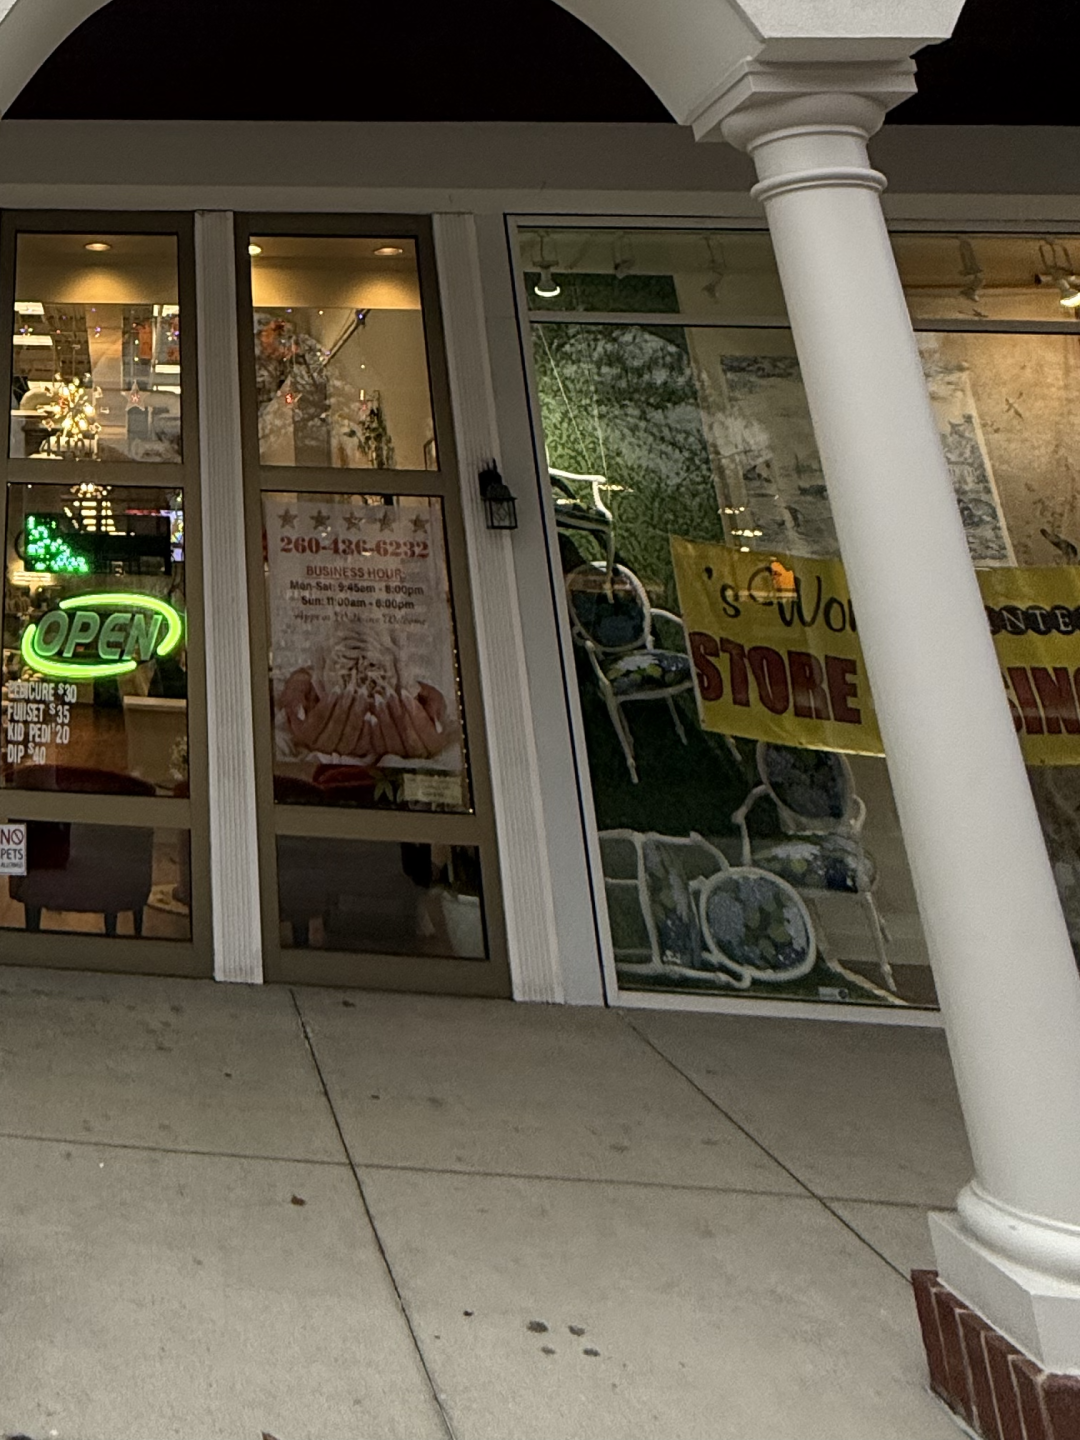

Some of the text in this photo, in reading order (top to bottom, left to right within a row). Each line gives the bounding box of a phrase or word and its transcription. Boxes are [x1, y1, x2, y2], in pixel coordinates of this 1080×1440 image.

[280, 536, 429, 559] 260-436-6232
[306, 565, 365, 578] BUSINESS
[990, 609, 1080, 632] NTE
[34, 610, 162, 660] OPEN
[689, 631, 862, 725] STORE
[58, 683, 77, 703] $30
[49, 703, 70, 724] $35
[8, 722, 25, 741] KID
[29, 724, 51, 743] PEDI
[7, 743, 46, 765] DIP $40
[0, 828, 24, 846] NO
[1, 848, 24, 861] PETS
